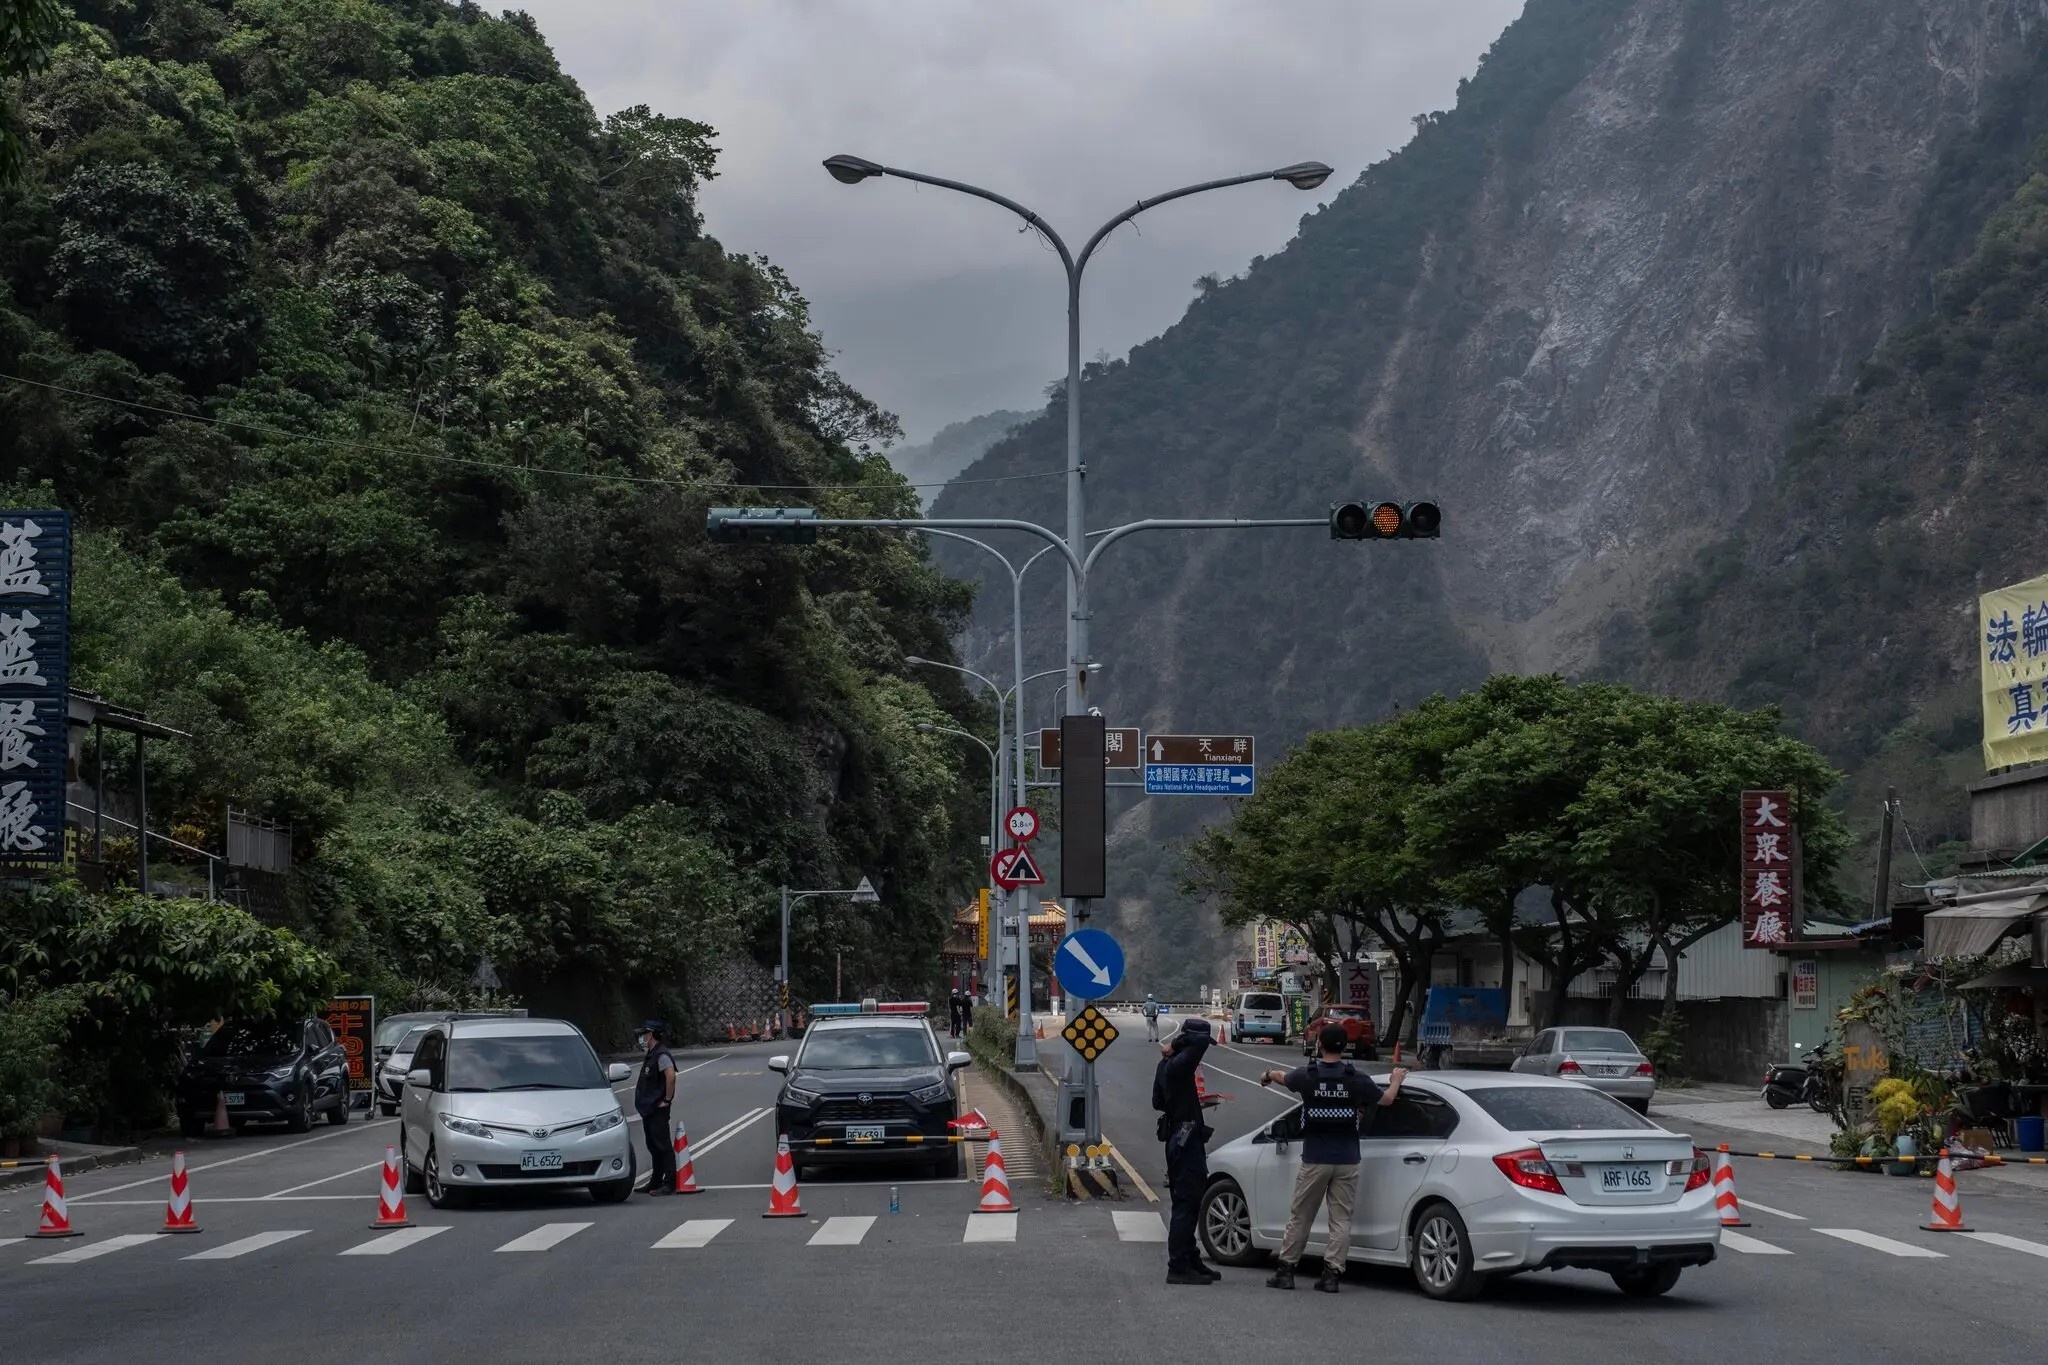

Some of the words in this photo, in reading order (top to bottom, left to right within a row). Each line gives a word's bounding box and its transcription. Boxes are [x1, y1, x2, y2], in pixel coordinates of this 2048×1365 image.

[1987, 600, 2048, 663] 法輪
[2008, 676, 2048, 736] 真
[1198, 738, 1248, 753] 天祥
[1204, 754, 1242, 763] Tianxiang
[1147, 768, 1230, 783] 太魯閣國家公園管理處
[1195, 784, 1230, 792] Headquarters
[1750, 796, 1789, 945] 大眾餐廳
[1843, 1045, 1889, 1071] Truku
[1314, 1090, 1349, 1098] POLICE
[521, 1155, 563, 1168] AFL-6522
[1603, 1170, 1652, 1187] ARF-1663
